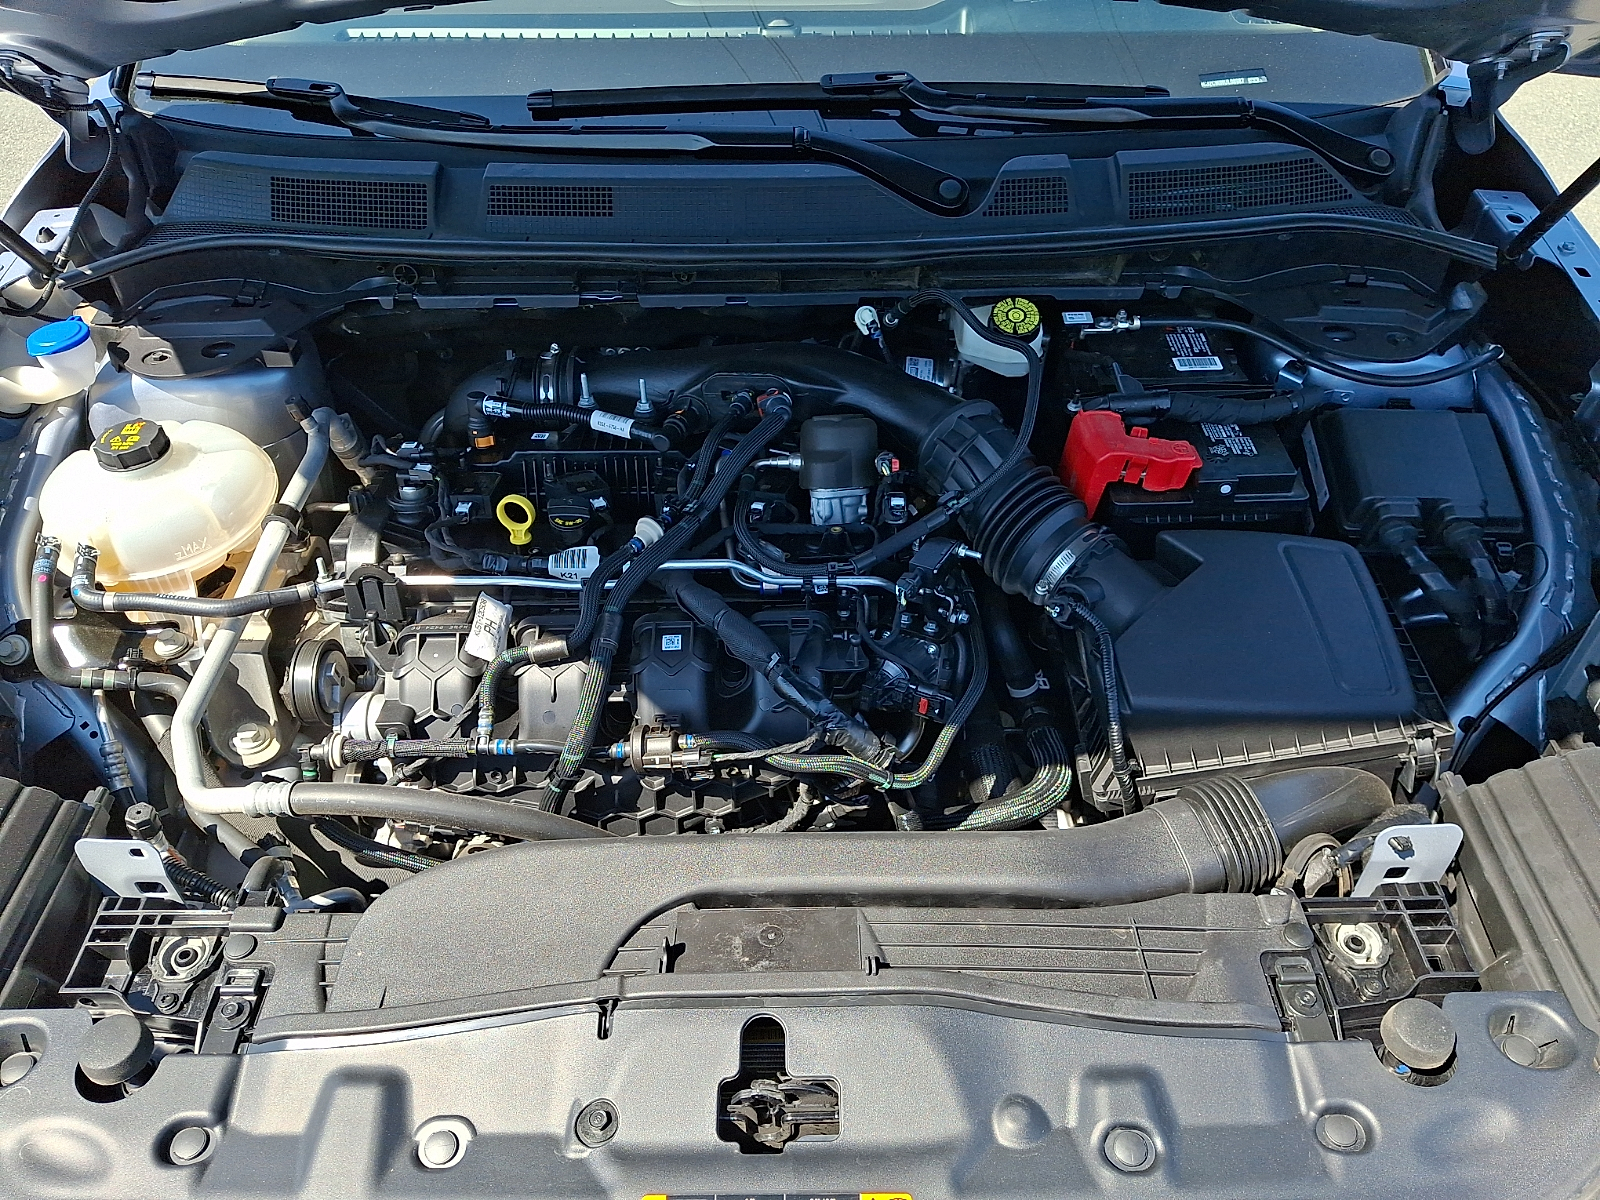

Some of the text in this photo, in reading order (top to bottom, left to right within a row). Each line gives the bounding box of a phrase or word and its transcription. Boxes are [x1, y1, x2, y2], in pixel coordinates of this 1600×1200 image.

[181, 536, 207, 557] MAX
[560, 572, 578, 580] K21
[483, 617, 498, 637] PH
